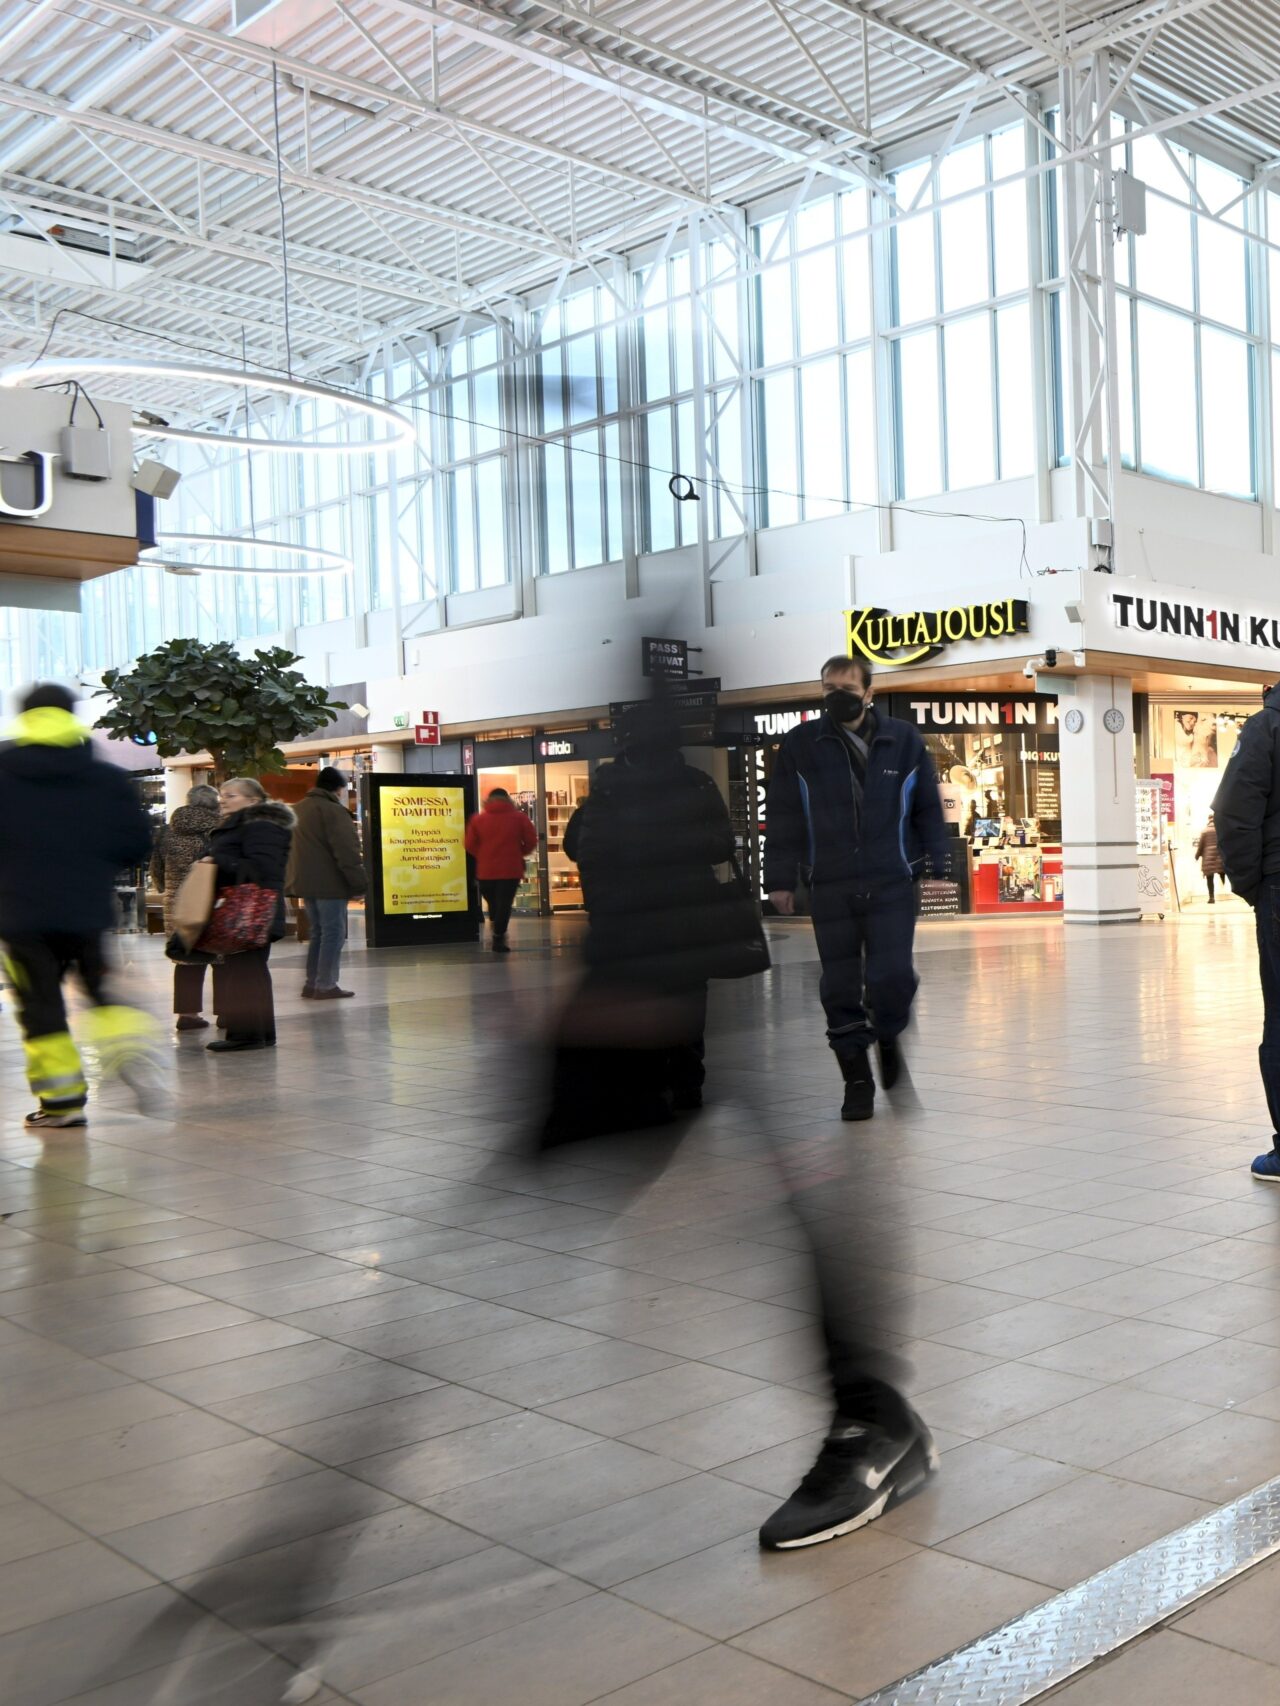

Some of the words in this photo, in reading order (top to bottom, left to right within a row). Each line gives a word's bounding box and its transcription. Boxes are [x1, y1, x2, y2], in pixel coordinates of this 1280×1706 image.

[842, 598, 1016, 665] KULTAJOUSI
[548, 741, 571, 756] iittala
[1020, 750, 1061, 761] DIG1KU
[393, 797, 449, 806] SOMESSA
[391, 807, 452, 817] TAPAHTUU!
[411, 828, 441, 837] Hyppää
[389, 837, 459, 846] kauppakeskuksen
